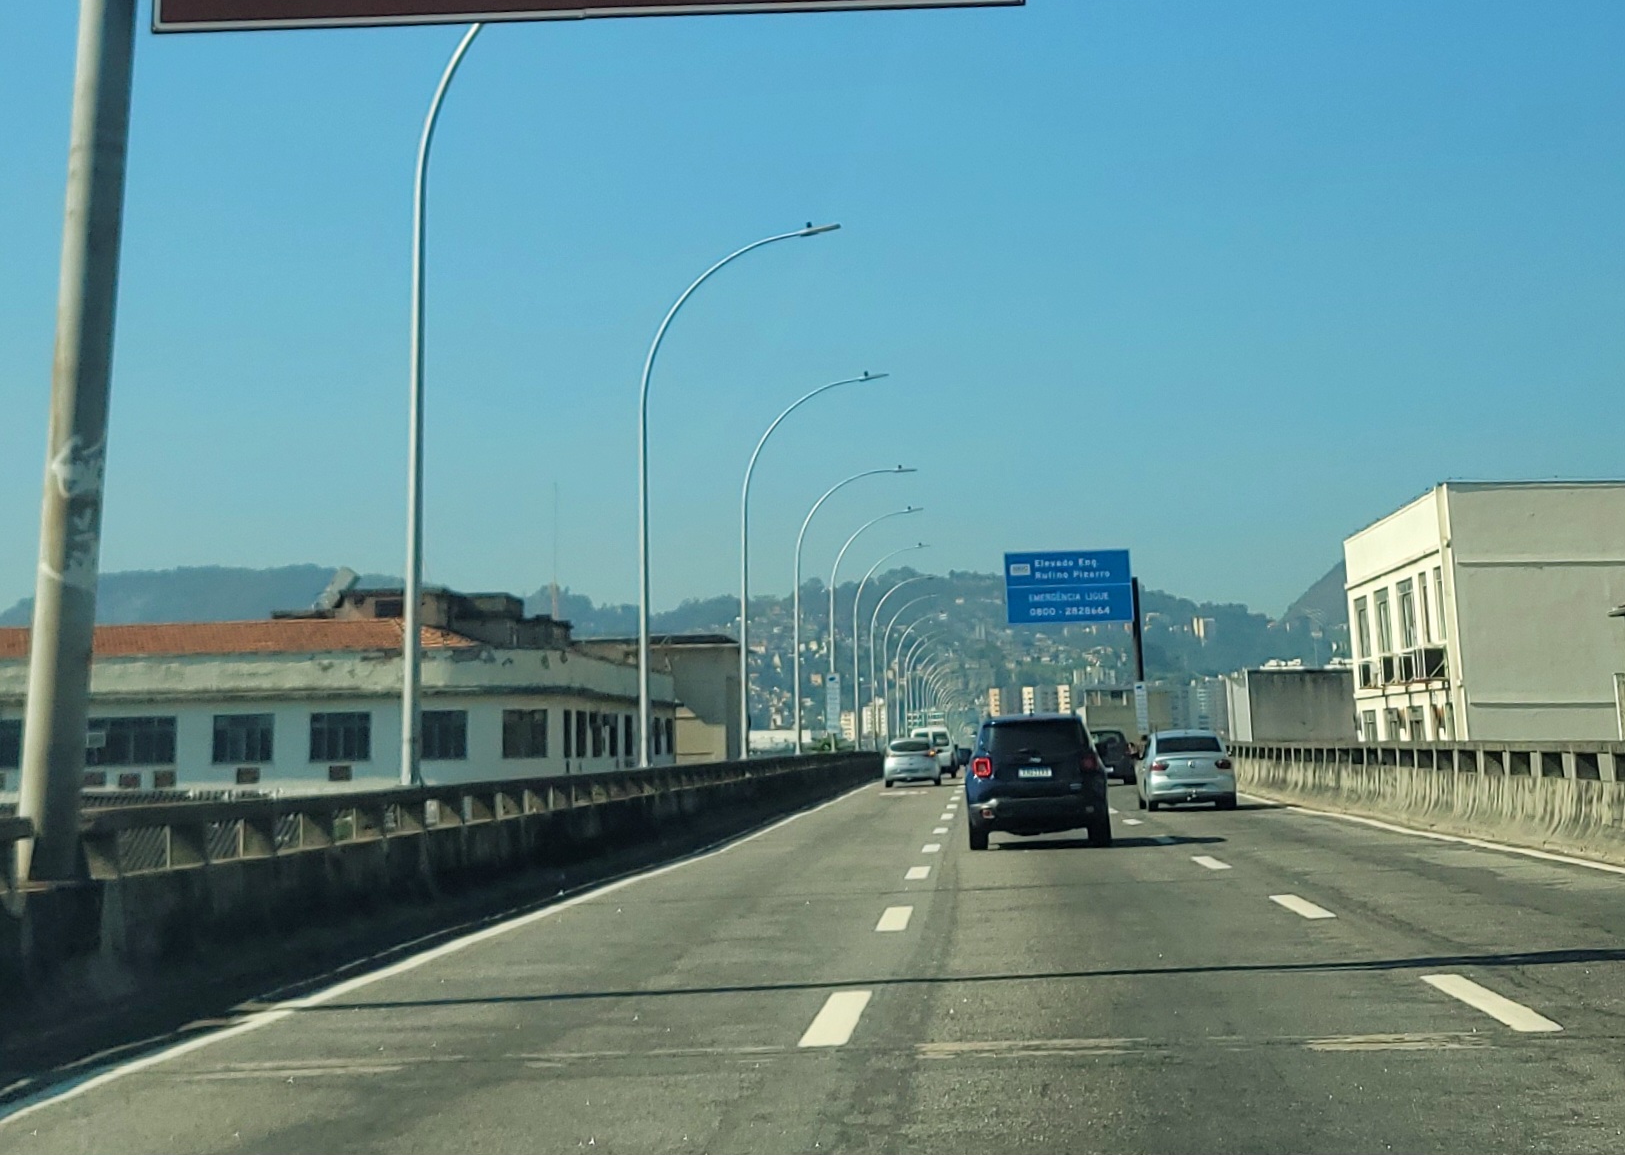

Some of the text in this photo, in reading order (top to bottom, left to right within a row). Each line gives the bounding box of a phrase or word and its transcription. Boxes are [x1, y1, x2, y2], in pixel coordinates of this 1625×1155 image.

[1034, 559, 1074, 567] Elevado
[1035, 570, 1111, 579] Rufino Pizarro
[1029, 591, 1109, 602] EMERGÊNCIA LIGUE
[1030, 608, 1056, 616] 0800
